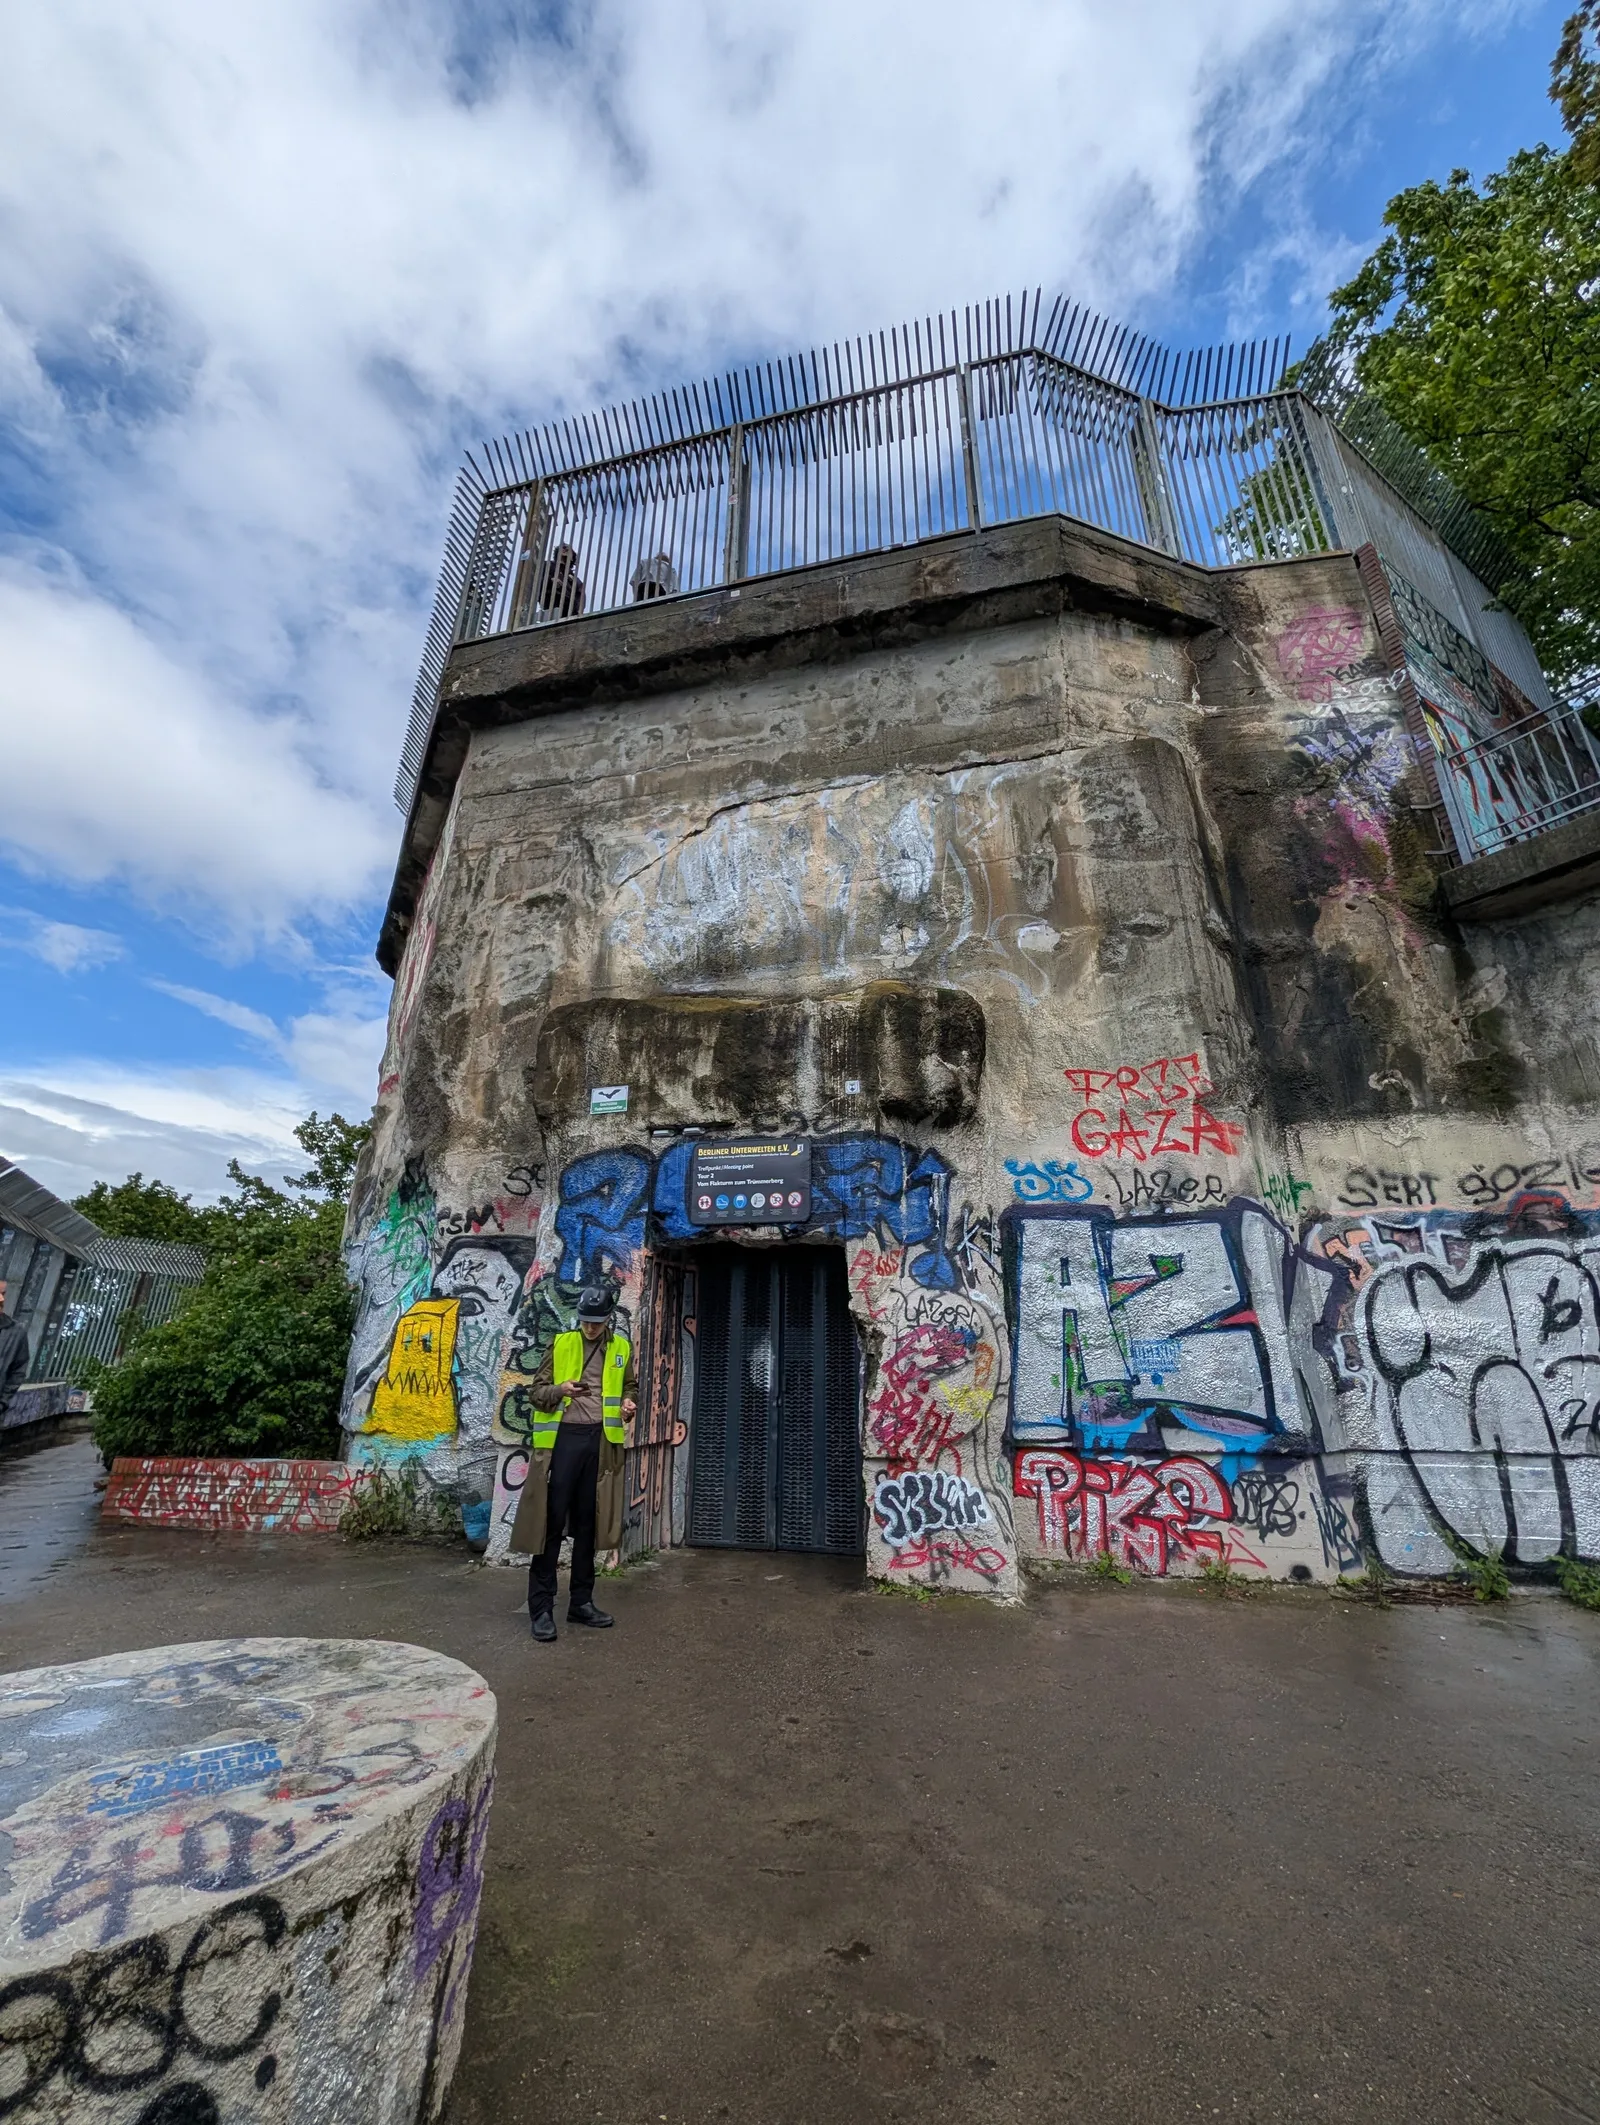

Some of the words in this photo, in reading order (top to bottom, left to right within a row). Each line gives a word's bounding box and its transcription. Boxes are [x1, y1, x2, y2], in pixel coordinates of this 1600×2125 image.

[1072, 1102, 1244, 1161] GAZA
[698, 1148, 729, 1156] BERLINER
[731, 1146, 776, 1154] UNTERWELTEN
